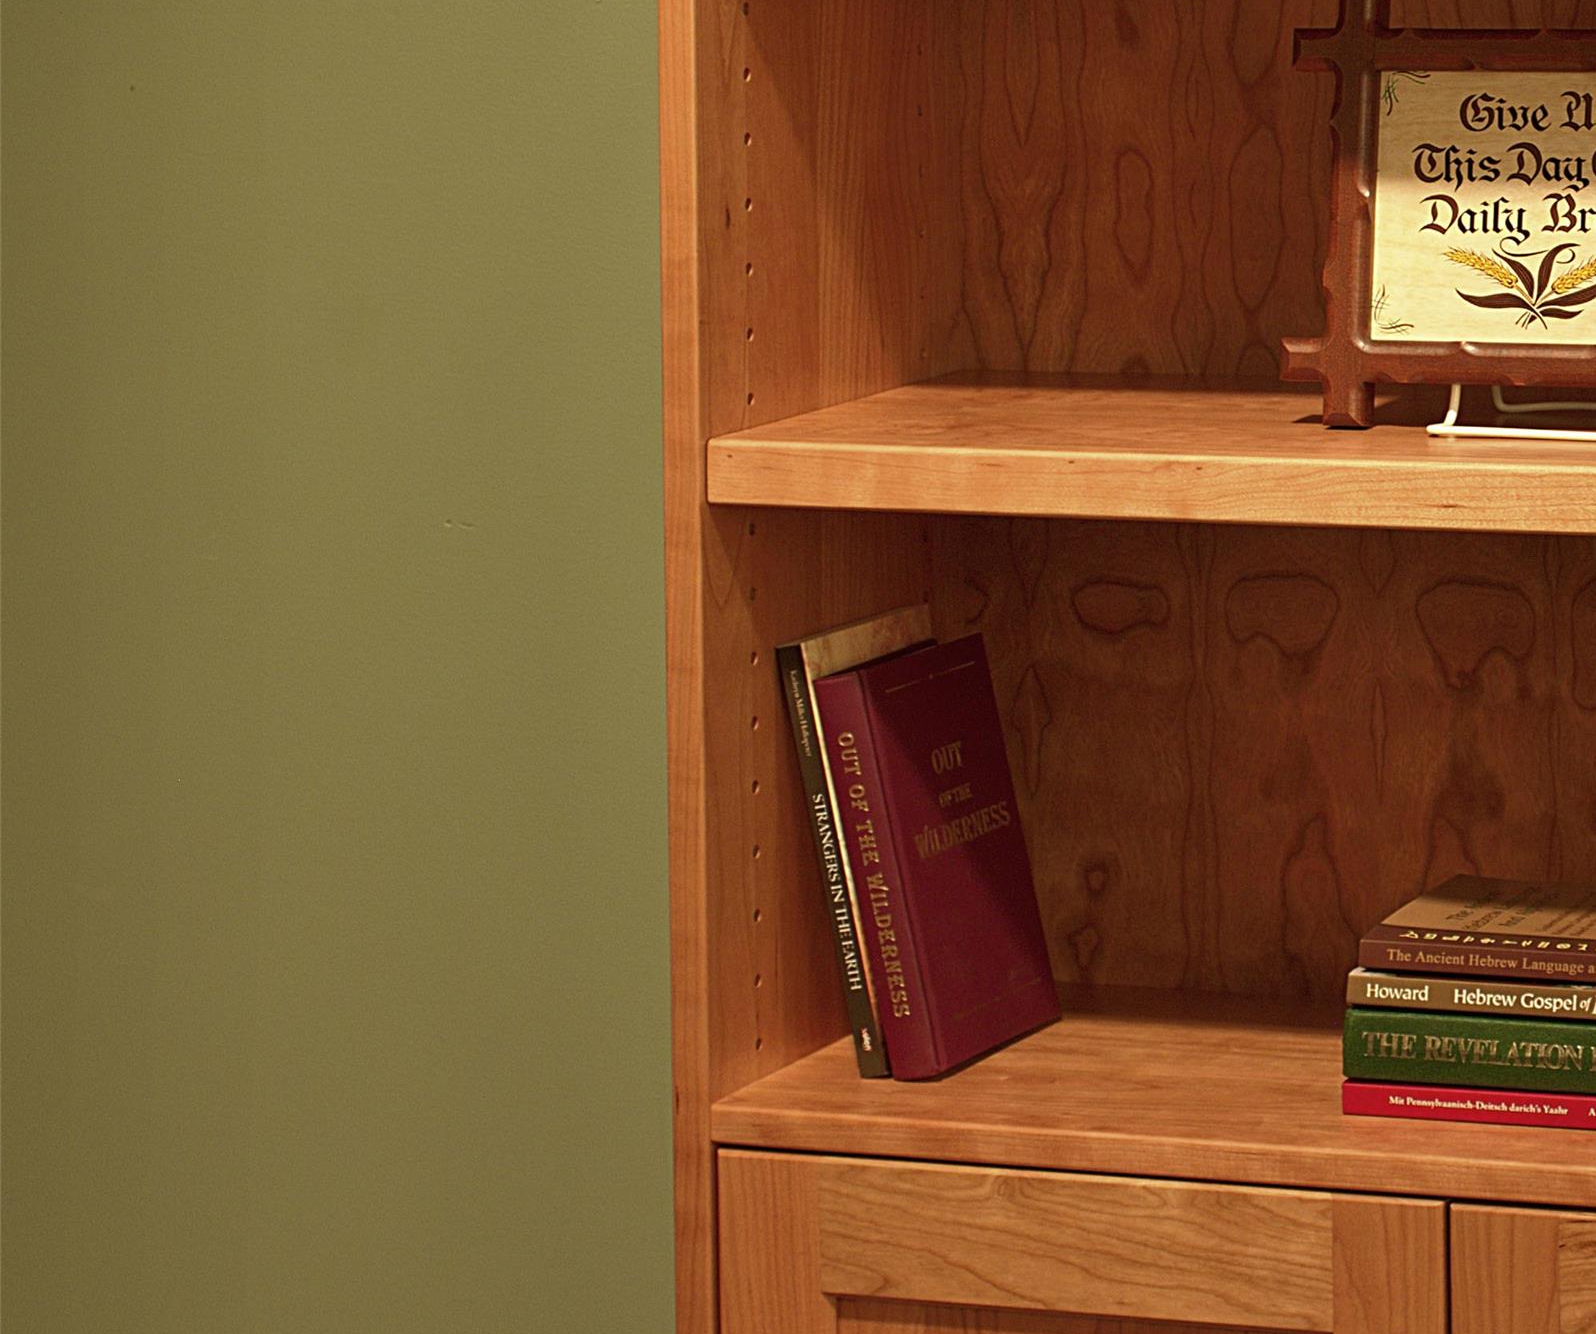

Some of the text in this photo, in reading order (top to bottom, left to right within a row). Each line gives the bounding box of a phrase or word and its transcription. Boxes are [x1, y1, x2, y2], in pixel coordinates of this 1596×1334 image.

[1459, 92, 1552, 132] Give
[1412, 143, 1501, 191] This
[1505, 142, 1589, 191] Day
[1419, 195, 1530, 245] Daily
[838, 731, 862, 775] OUT
[931, 741, 962, 775] OUT
[849, 784, 870, 811] OF
[856, 819, 880, 866] THE
[914, 801, 1010, 859] WILDERNESS
[812, 793, 862, 991] STRANGERS IN THE EARTH
[866, 873, 910, 1017] WILDERNESS
[1386, 949, 1412, 963] The
[1415, 951, 1465, 966] Ancient
[1469, 955, 1518, 969] Hebrew
[1522, 958, 1584, 975] Language
[1366, 983, 1429, 1001] Howard
[1454, 989, 1516, 1007] Hebrew
[1520, 993, 1577, 1013] Gospel
[1580, 997, 1593, 1012] of
[1362, 1032, 1416, 1059] THE
[1423, 1035, 1584, 1071] REVELATION
[1388, 1096, 1405, 1105] Mit
[1543, 1104, 1568, 1115] Yaahr
[1588, 1107, 1596, 1117] A
